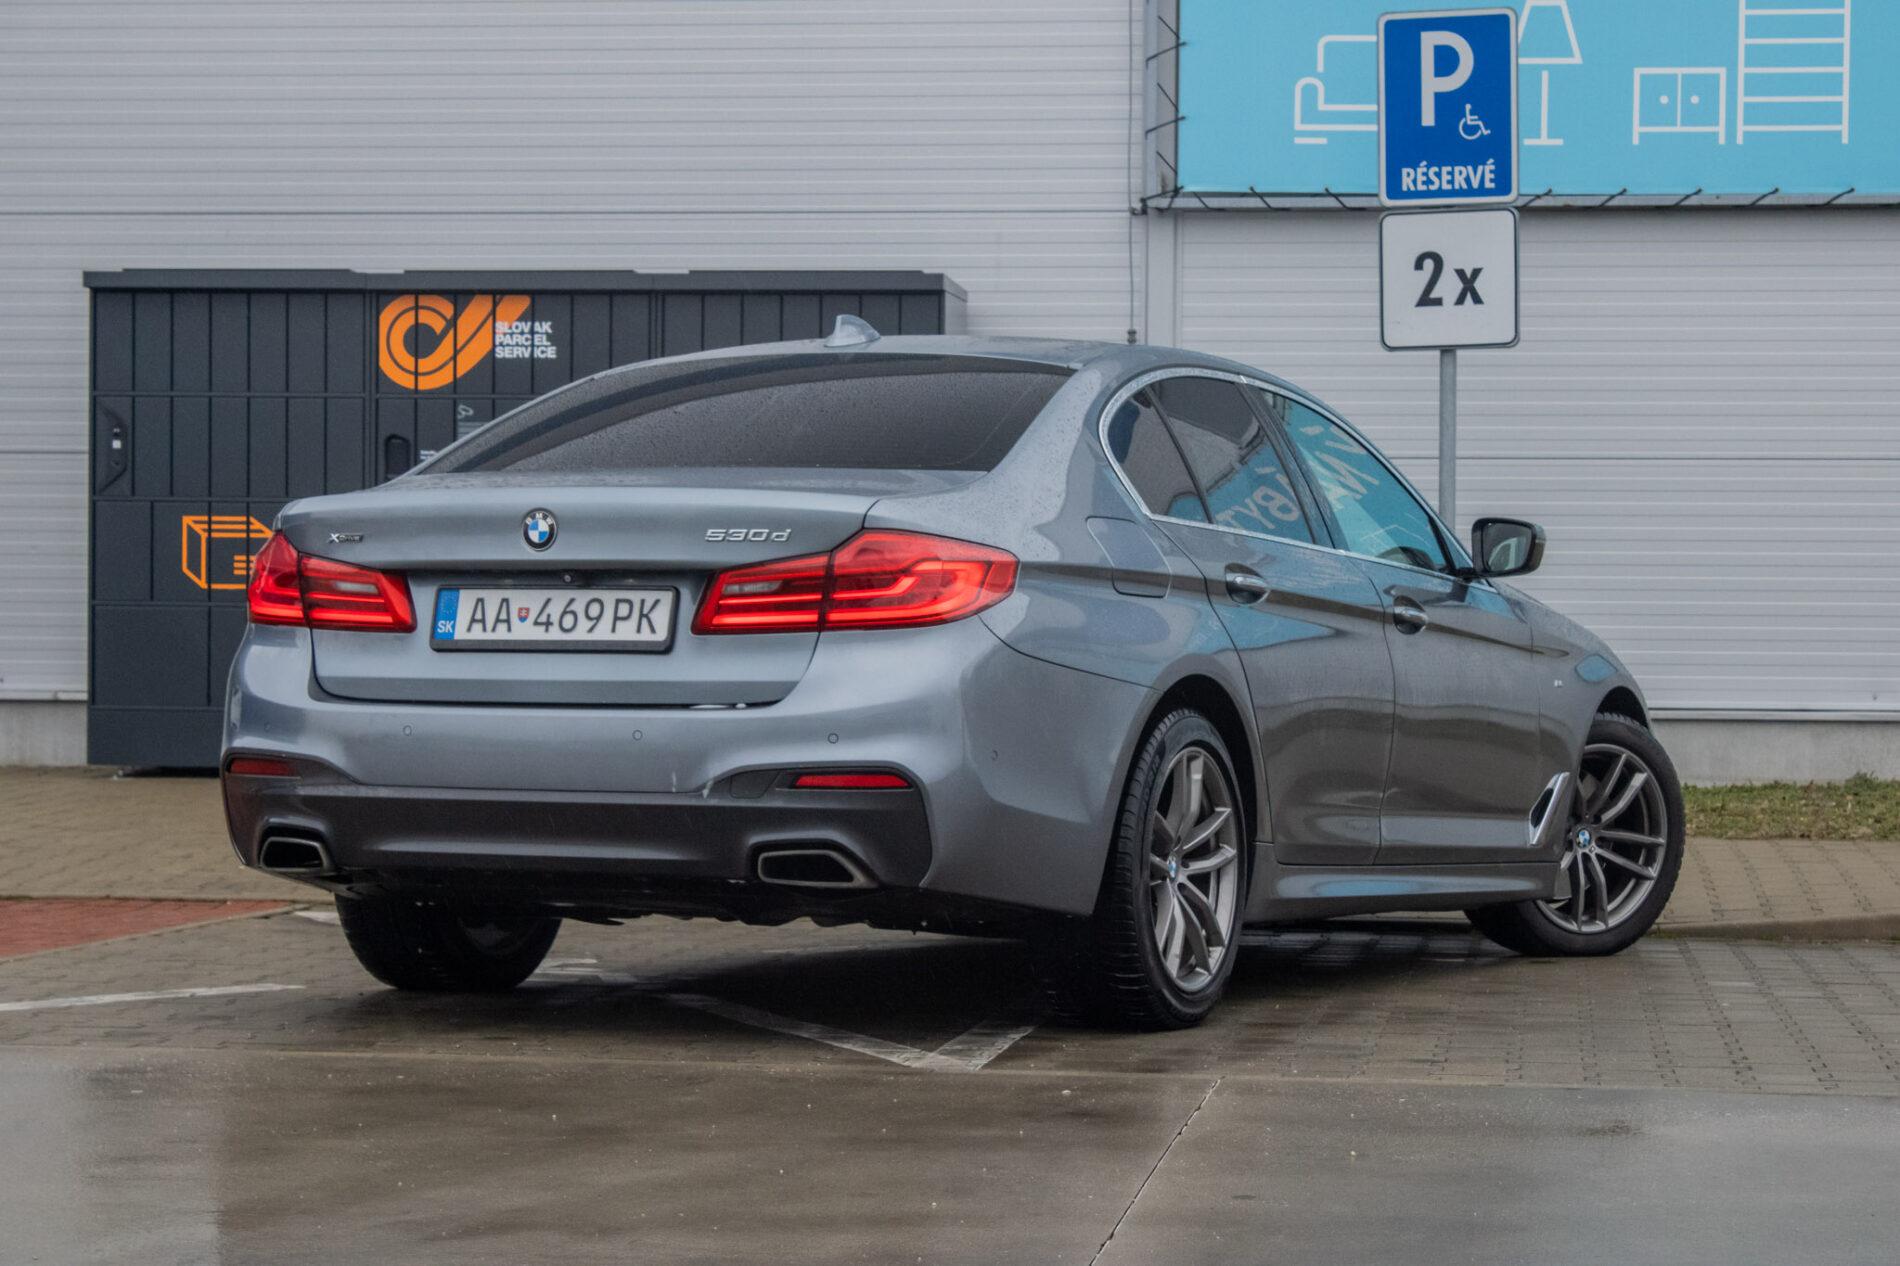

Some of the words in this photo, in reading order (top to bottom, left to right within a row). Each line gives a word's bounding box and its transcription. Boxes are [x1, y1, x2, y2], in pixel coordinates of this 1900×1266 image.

[1420, 30, 1474, 127] P
[1401, 158, 1496, 192] RÉSERVÉ
[495, 321, 552, 333] SLOVAK
[495, 334, 551, 345] PARCEL
[495, 346, 557, 358] SERVICE
[525, 511, 554, 526] BMW
[704, 528, 792, 541] 530d
[437, 619, 454, 634] SK
